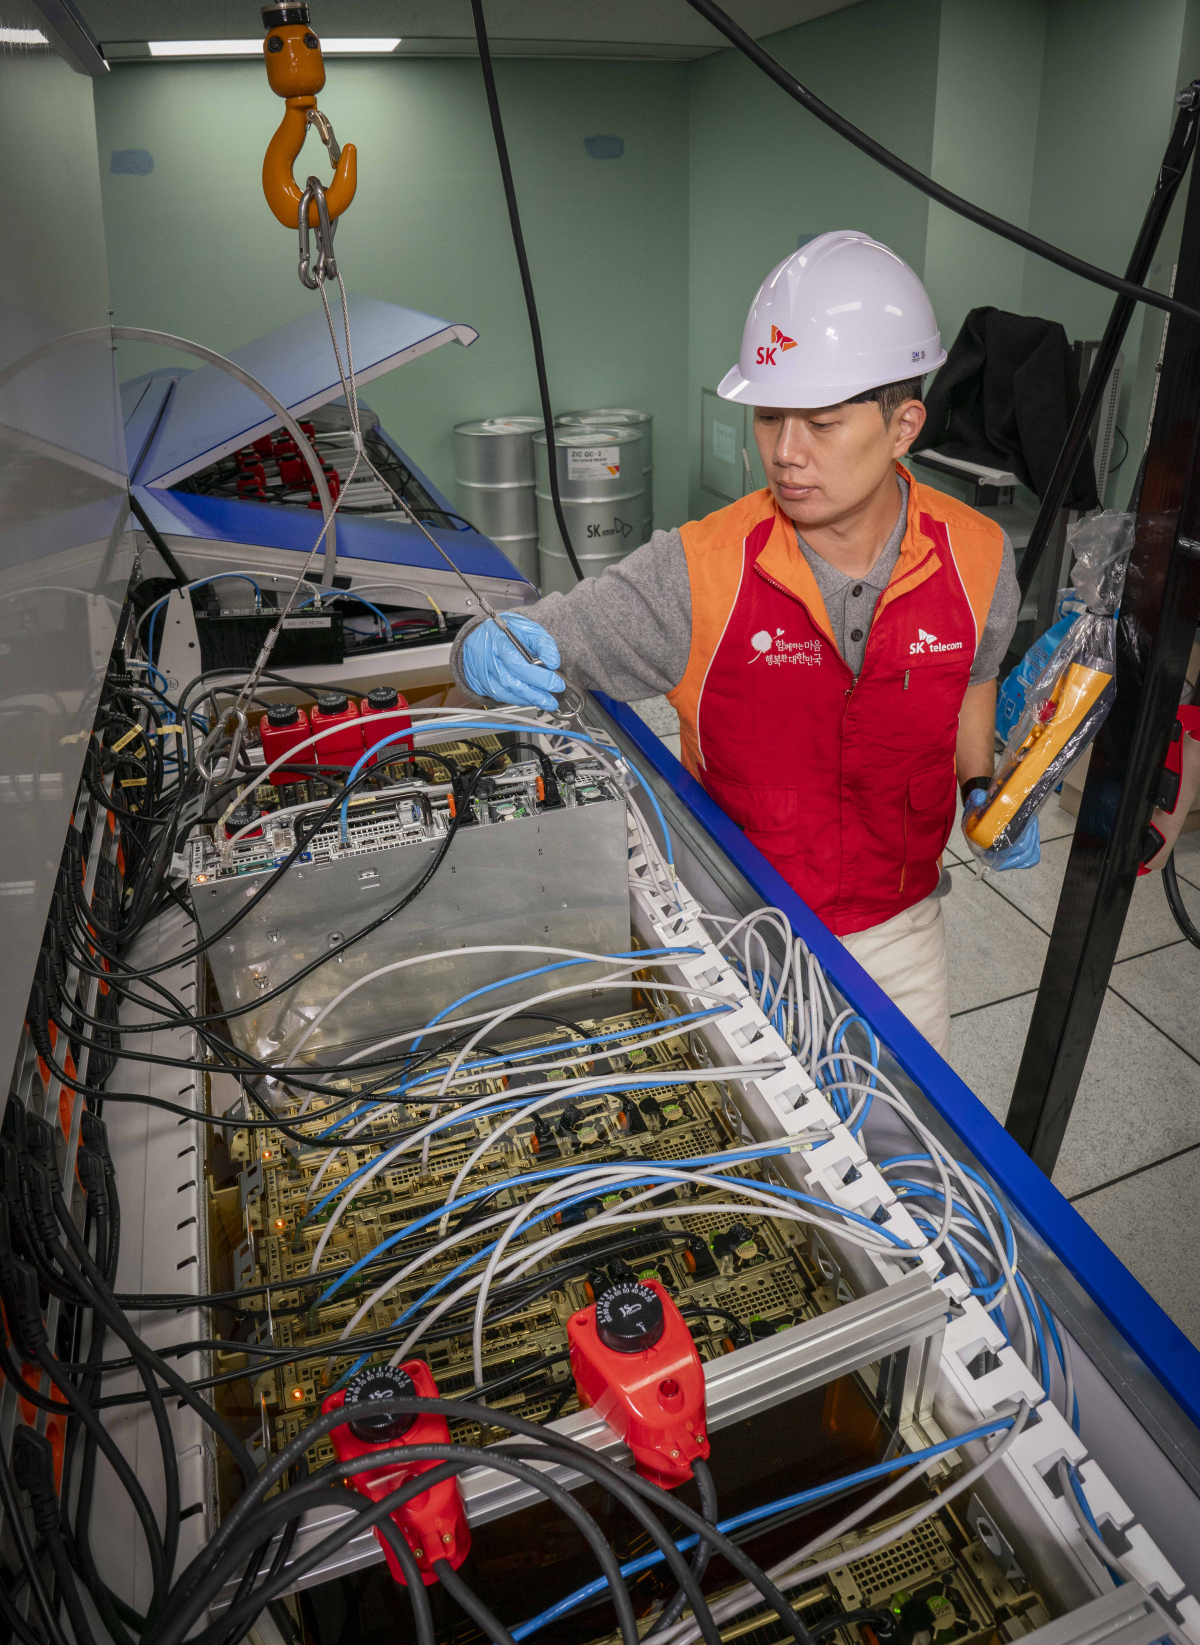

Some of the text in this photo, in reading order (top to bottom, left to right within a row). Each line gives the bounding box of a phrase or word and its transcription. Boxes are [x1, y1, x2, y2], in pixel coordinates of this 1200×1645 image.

[756, 347, 778, 366] SK
[587, 524, 601, 538] SK
[775, 639, 822, 652] 함께하는 마음
[910, 642, 962, 655] SK telecom
[765, 652, 822, 667] 행복한 대한민국
[930, 1598, 942, 1608] EPP
